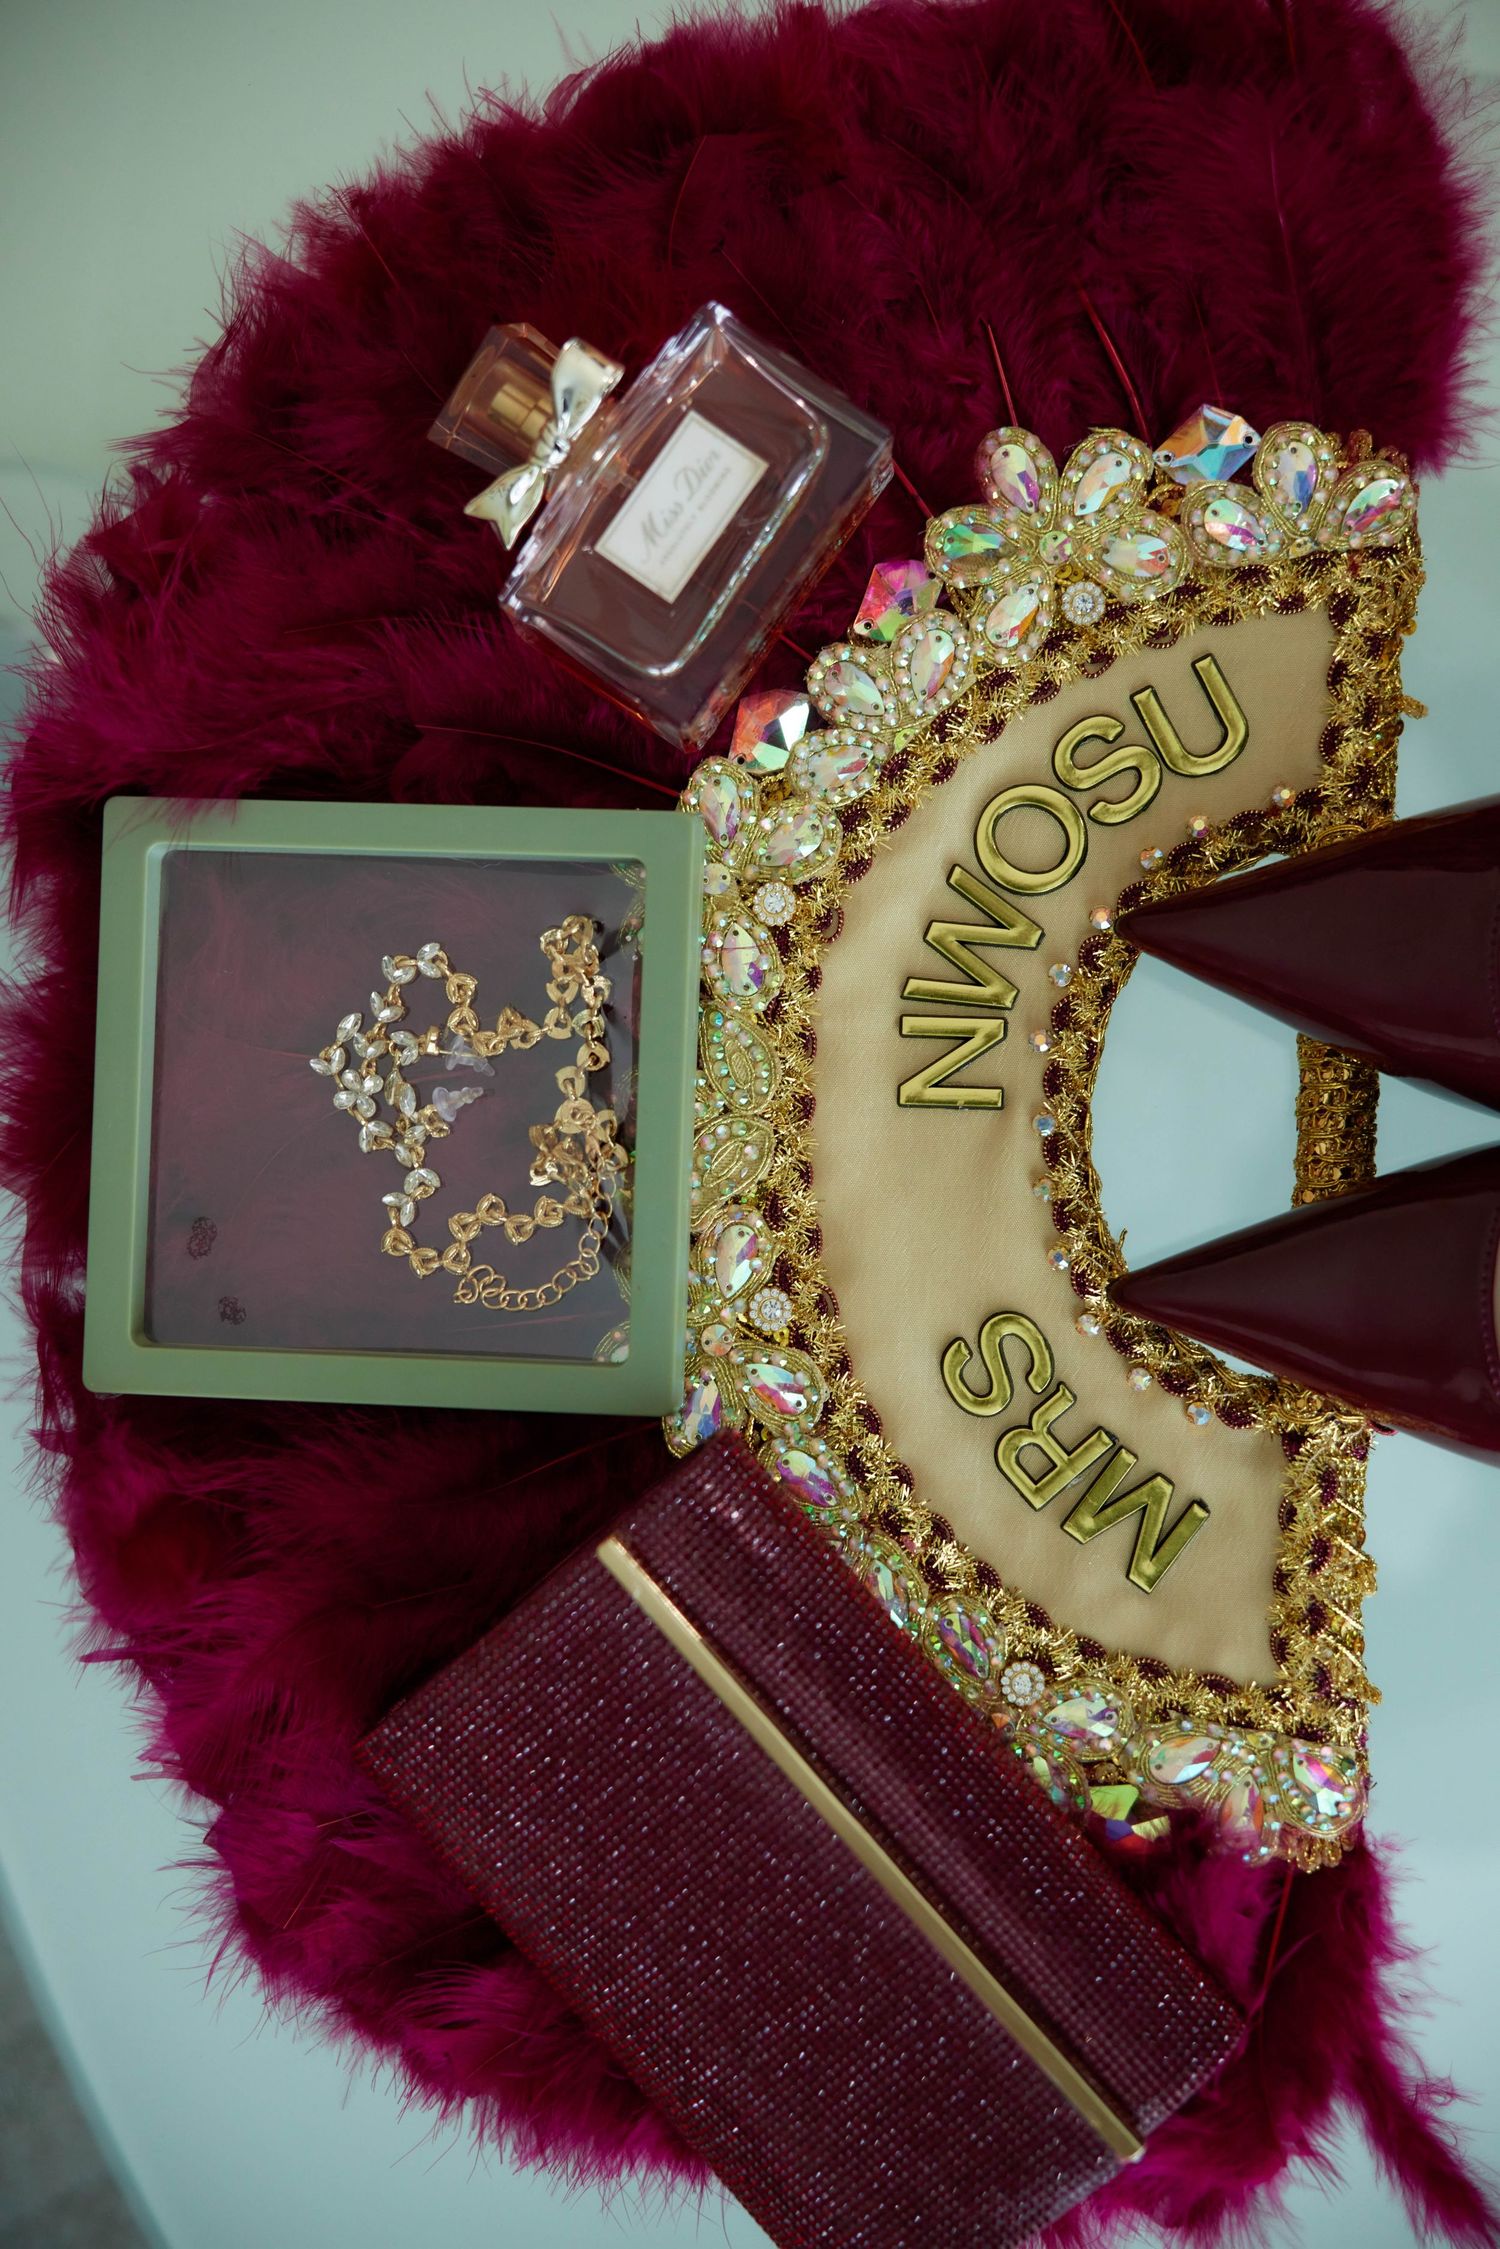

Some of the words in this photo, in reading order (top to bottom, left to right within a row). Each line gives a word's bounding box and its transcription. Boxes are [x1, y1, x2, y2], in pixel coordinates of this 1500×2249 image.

[640, 510, 684, 565] Miss
[673, 449, 722, 503] Dior
[897, 652, 1250, 1110] NWOSU
[940, 1310, 1211, 1594] MRS
